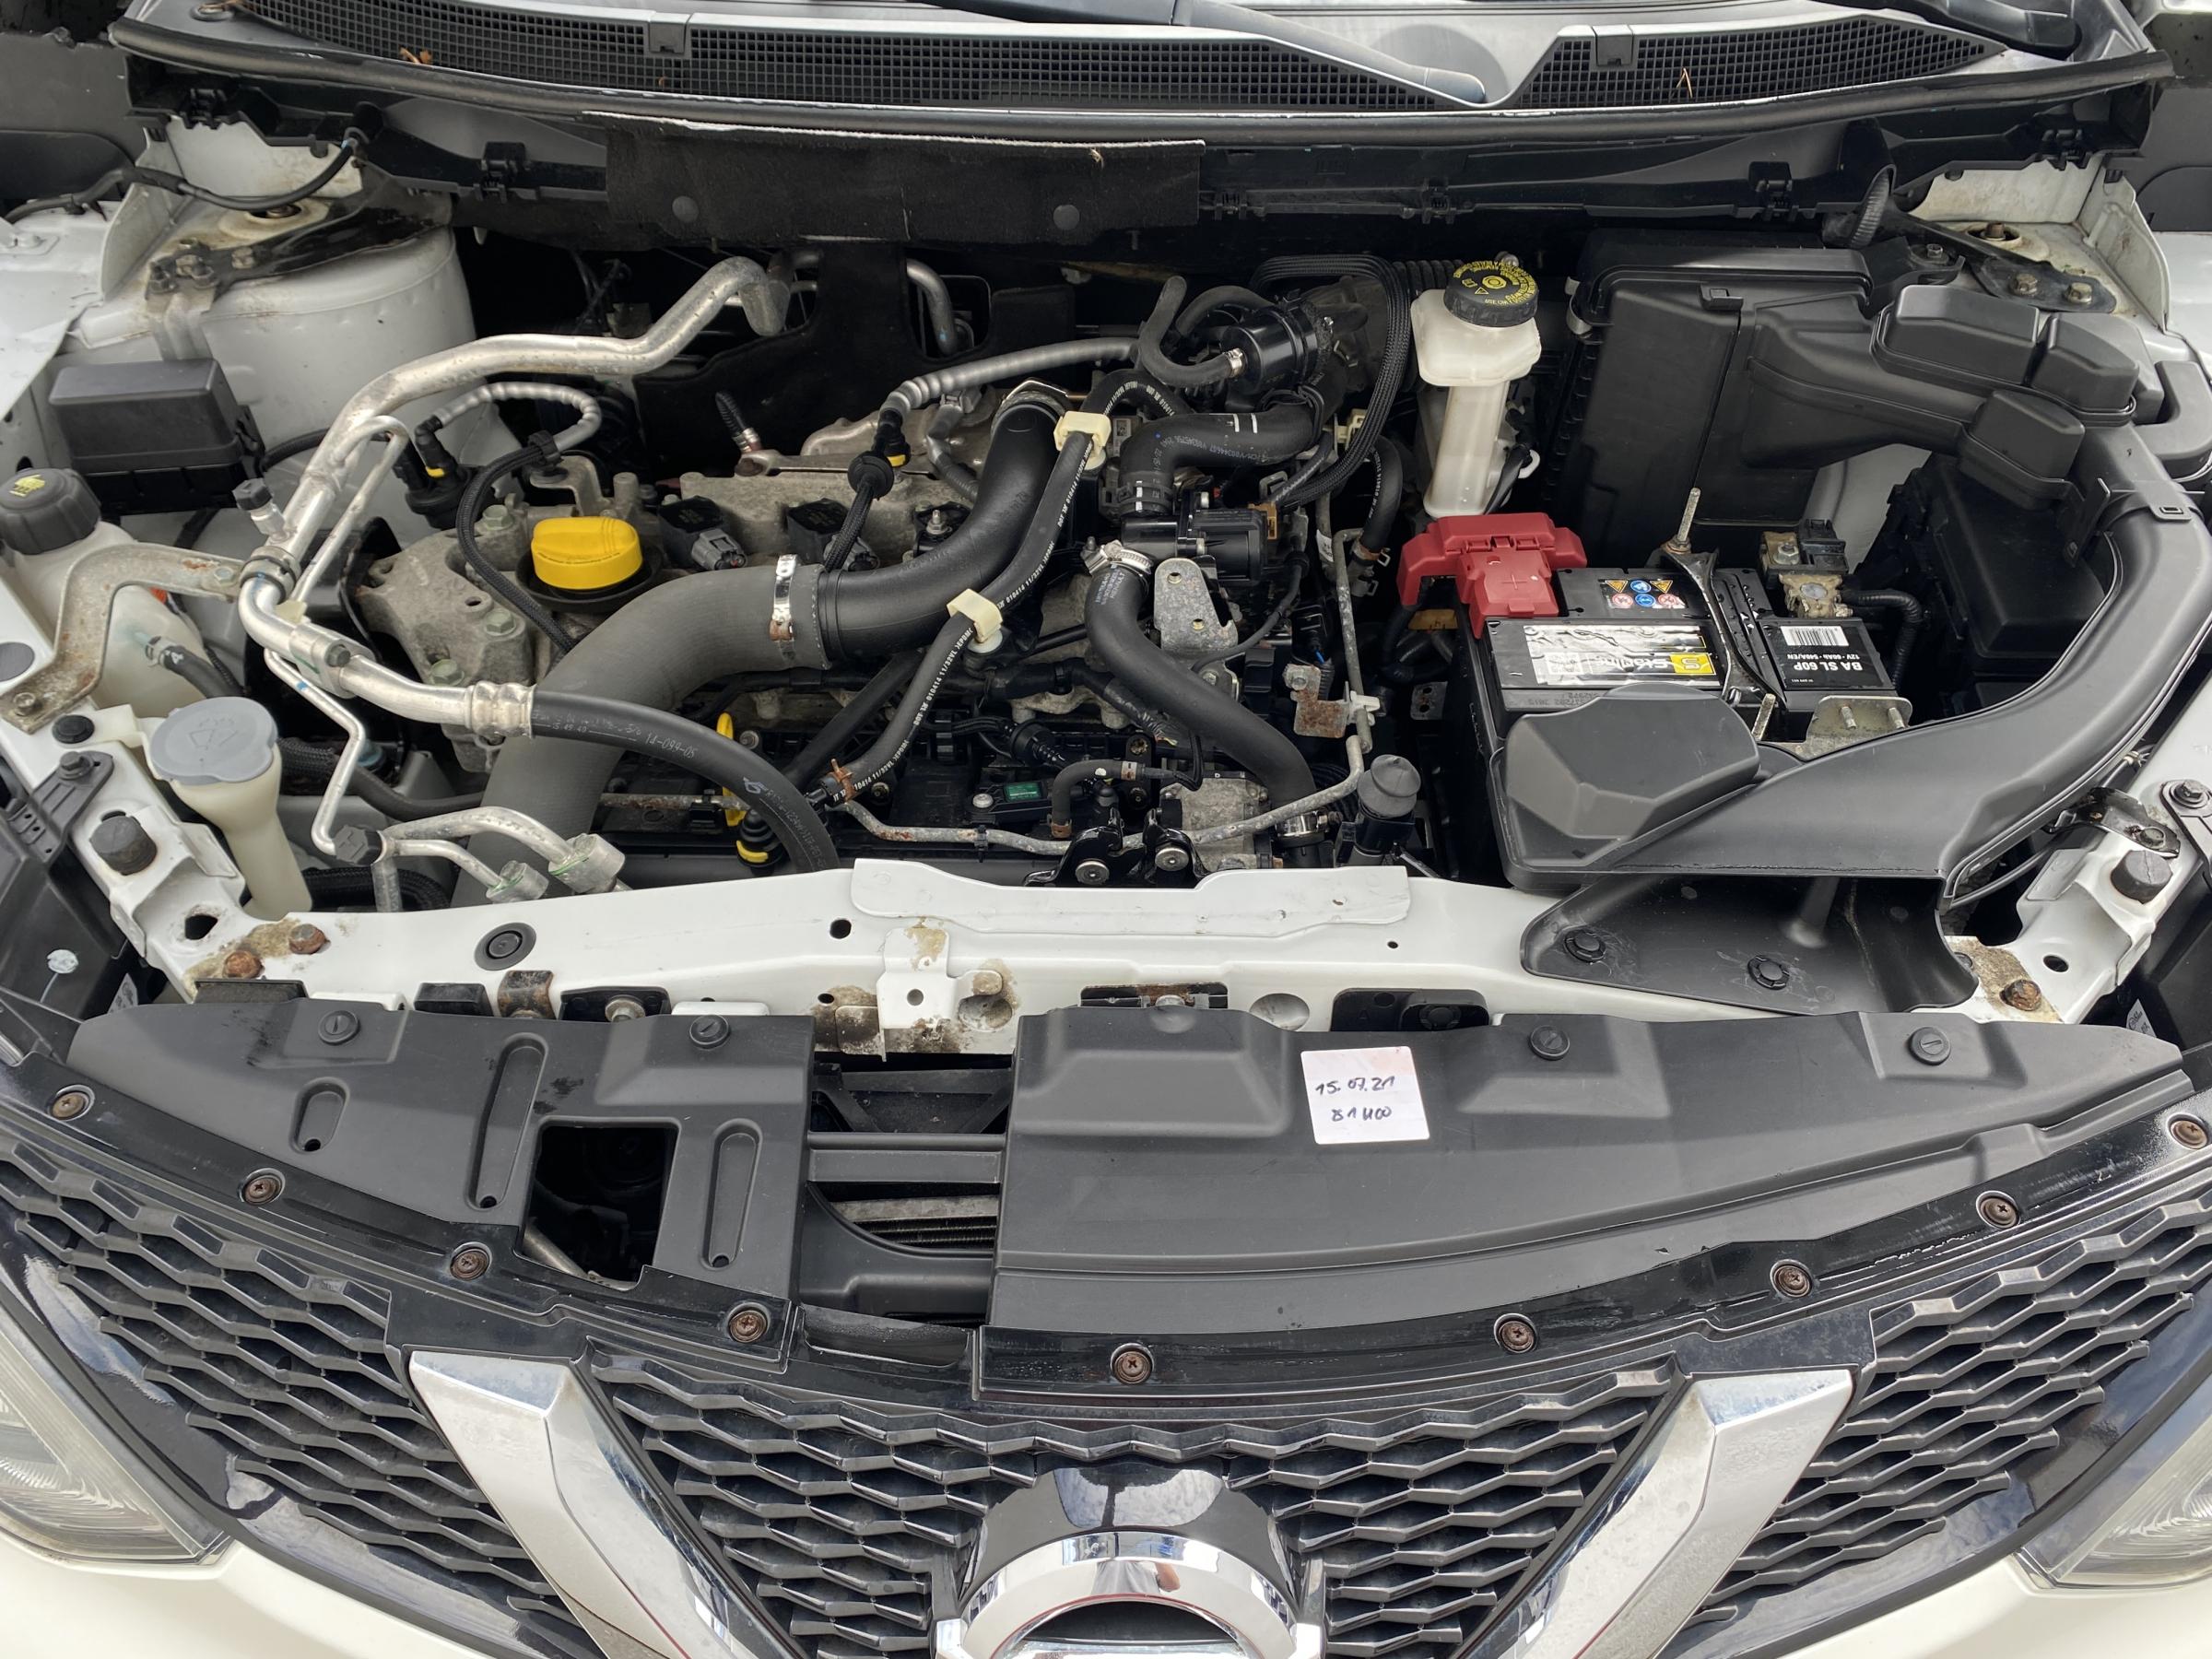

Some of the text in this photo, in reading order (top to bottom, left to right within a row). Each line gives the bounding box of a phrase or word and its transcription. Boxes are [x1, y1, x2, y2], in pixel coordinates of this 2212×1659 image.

[924, 676, 944, 702] 010414
[937, 649, 959, 677] 11/32VL
[1794, 661, 1864, 671] BA SL 60P
